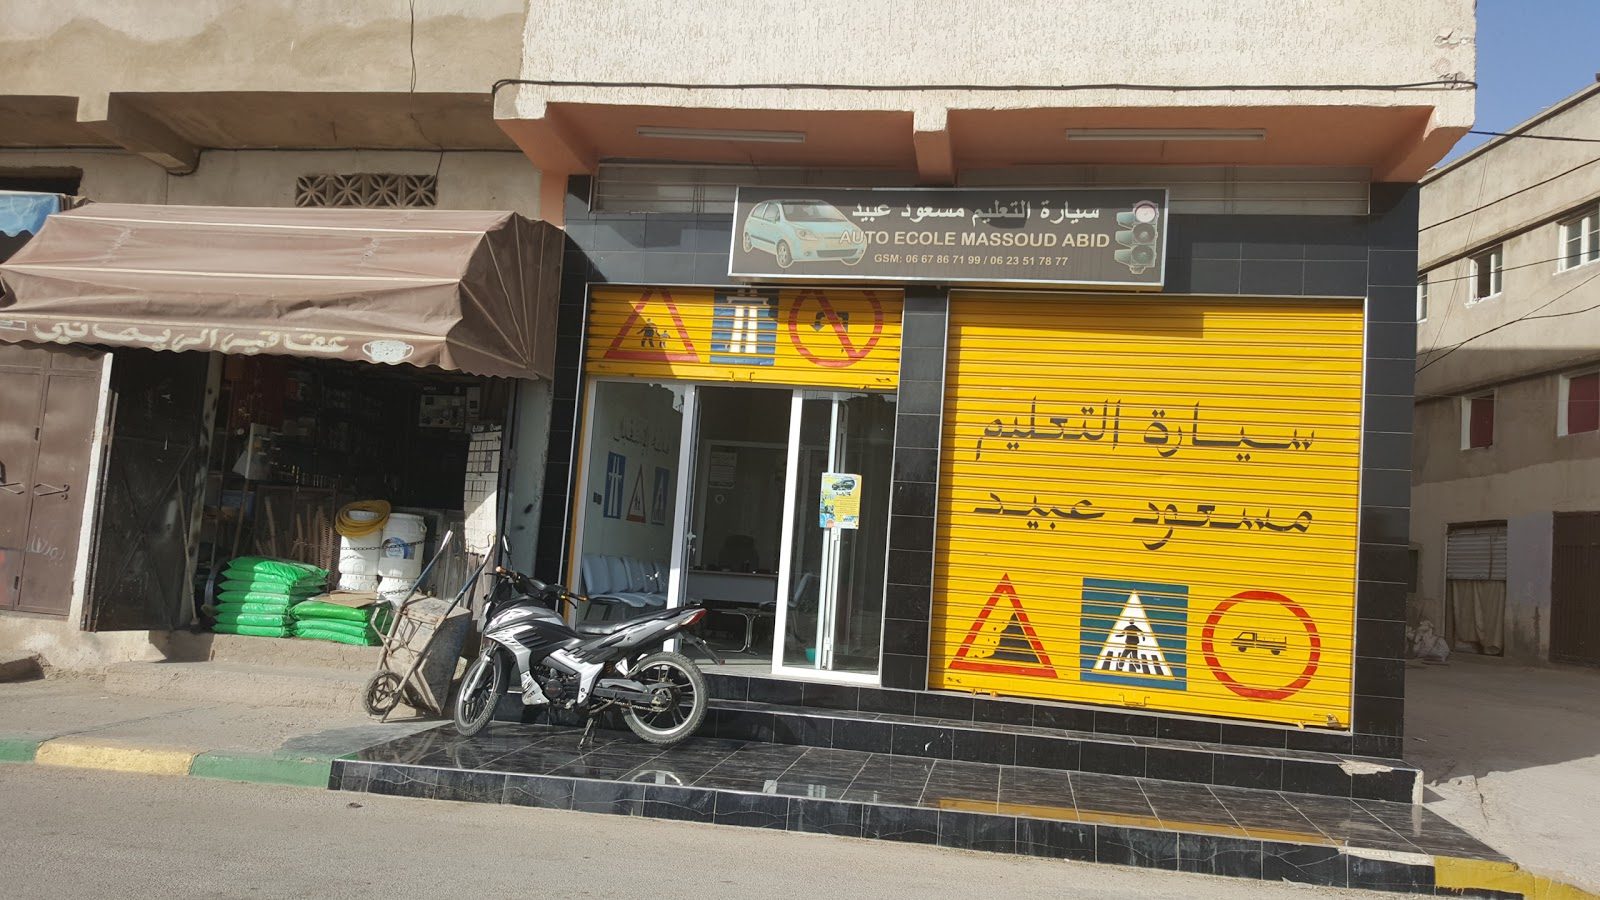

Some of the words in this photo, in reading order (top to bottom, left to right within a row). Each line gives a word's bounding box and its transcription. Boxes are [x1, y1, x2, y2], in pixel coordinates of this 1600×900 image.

[852, 203, 891, 223] عبيد
[901, 203, 965, 223] مسعود
[971, 199, 1031, 228] التعليم
[1040, 200, 1100, 225] سيارة
[839, 230, 889, 246] AUTO
[894, 231, 957, 246] ECOLE
[961, 232, 1057, 247] MASSOUD
[1061, 233, 1110, 248] ABID
[874, 254, 903, 263] GSM:
[905, 255, 918, 264] 06
[921, 255, 934, 264] 67
[936, 255, 950, 264] 86
[952, 255, 964, 265] 71
[967, 256, 981, 265] 99
[990, 256, 1003, 265] 06
[1006, 256, 1020, 265] 23
[1022, 257, 1035, 266] 51
[1039, 257, 1052, 266] 78
[1055, 257, 1069, 266] 77
[220, 330, 349, 355] عقاقير
[975, 395, 1122, 461] التعليم
[1143, 401, 1315, 462] سيارة
[974, 492, 1105, 530] عبيد
[1132, 501, 1313, 551] مسعود
